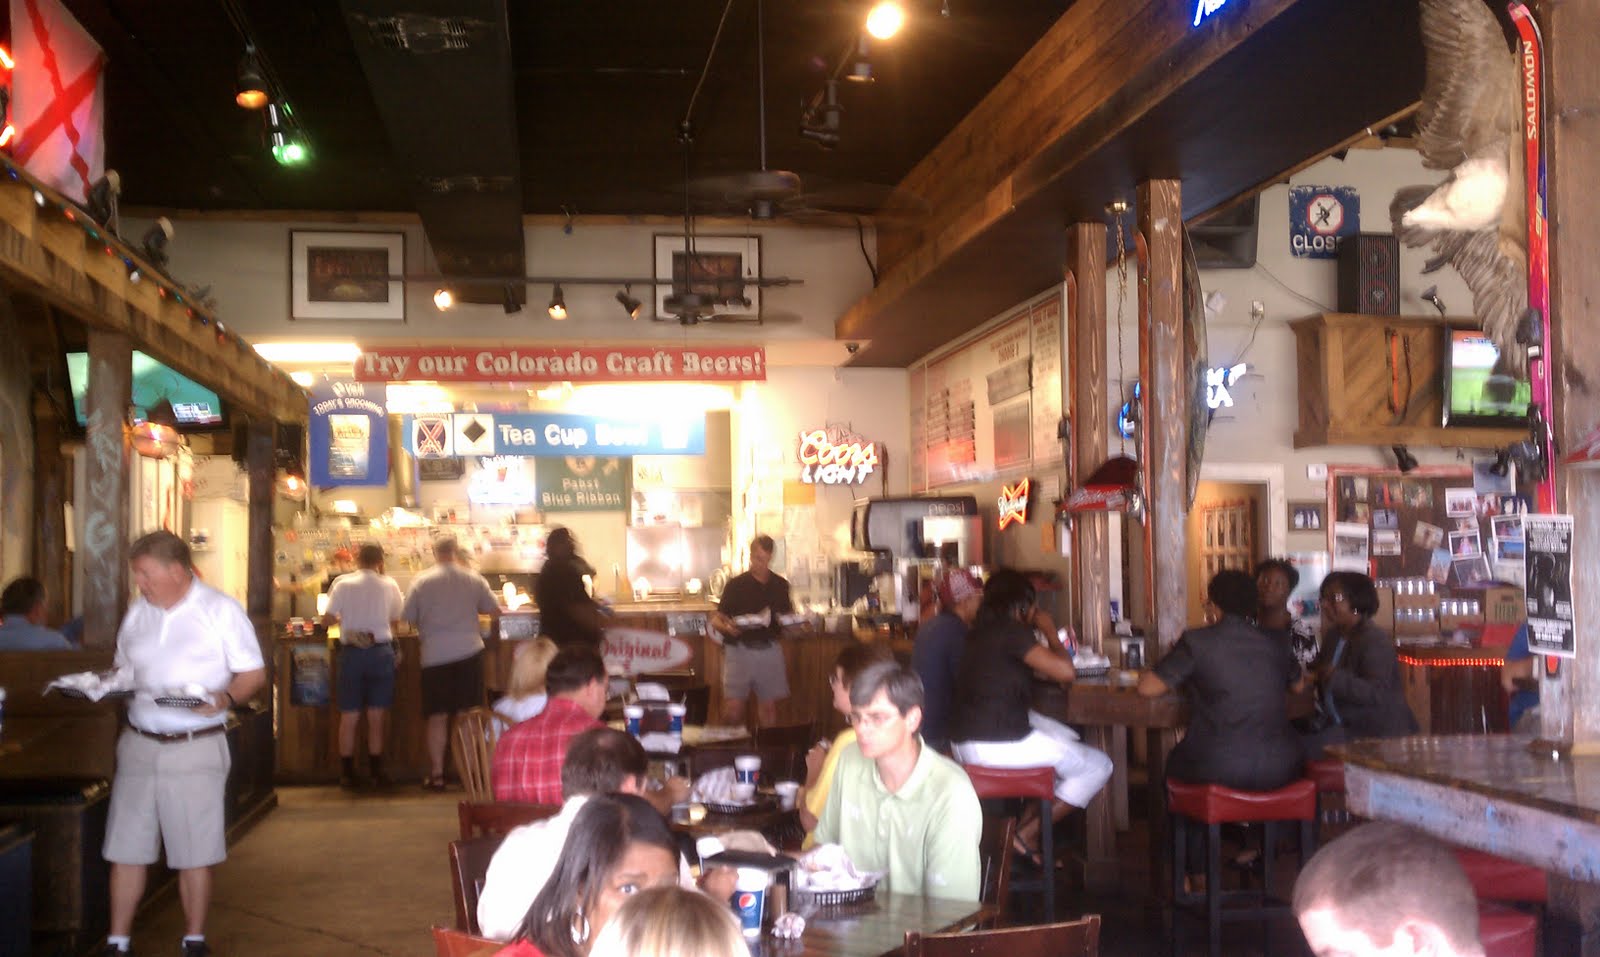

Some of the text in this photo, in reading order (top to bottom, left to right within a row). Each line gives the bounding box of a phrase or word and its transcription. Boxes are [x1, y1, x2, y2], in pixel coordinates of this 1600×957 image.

[1522, 41, 1537, 139] SALOMON
[363, 350, 762, 378] Try our Colorado Craft Beers!
[498, 424, 537, 446] Tea
[544, 423, 589, 449] Cup
[562, 477, 600, 492] Pabst
[541, 491, 622, 507] Blue Ribbon
[928, 500, 965, 517] pepsi
